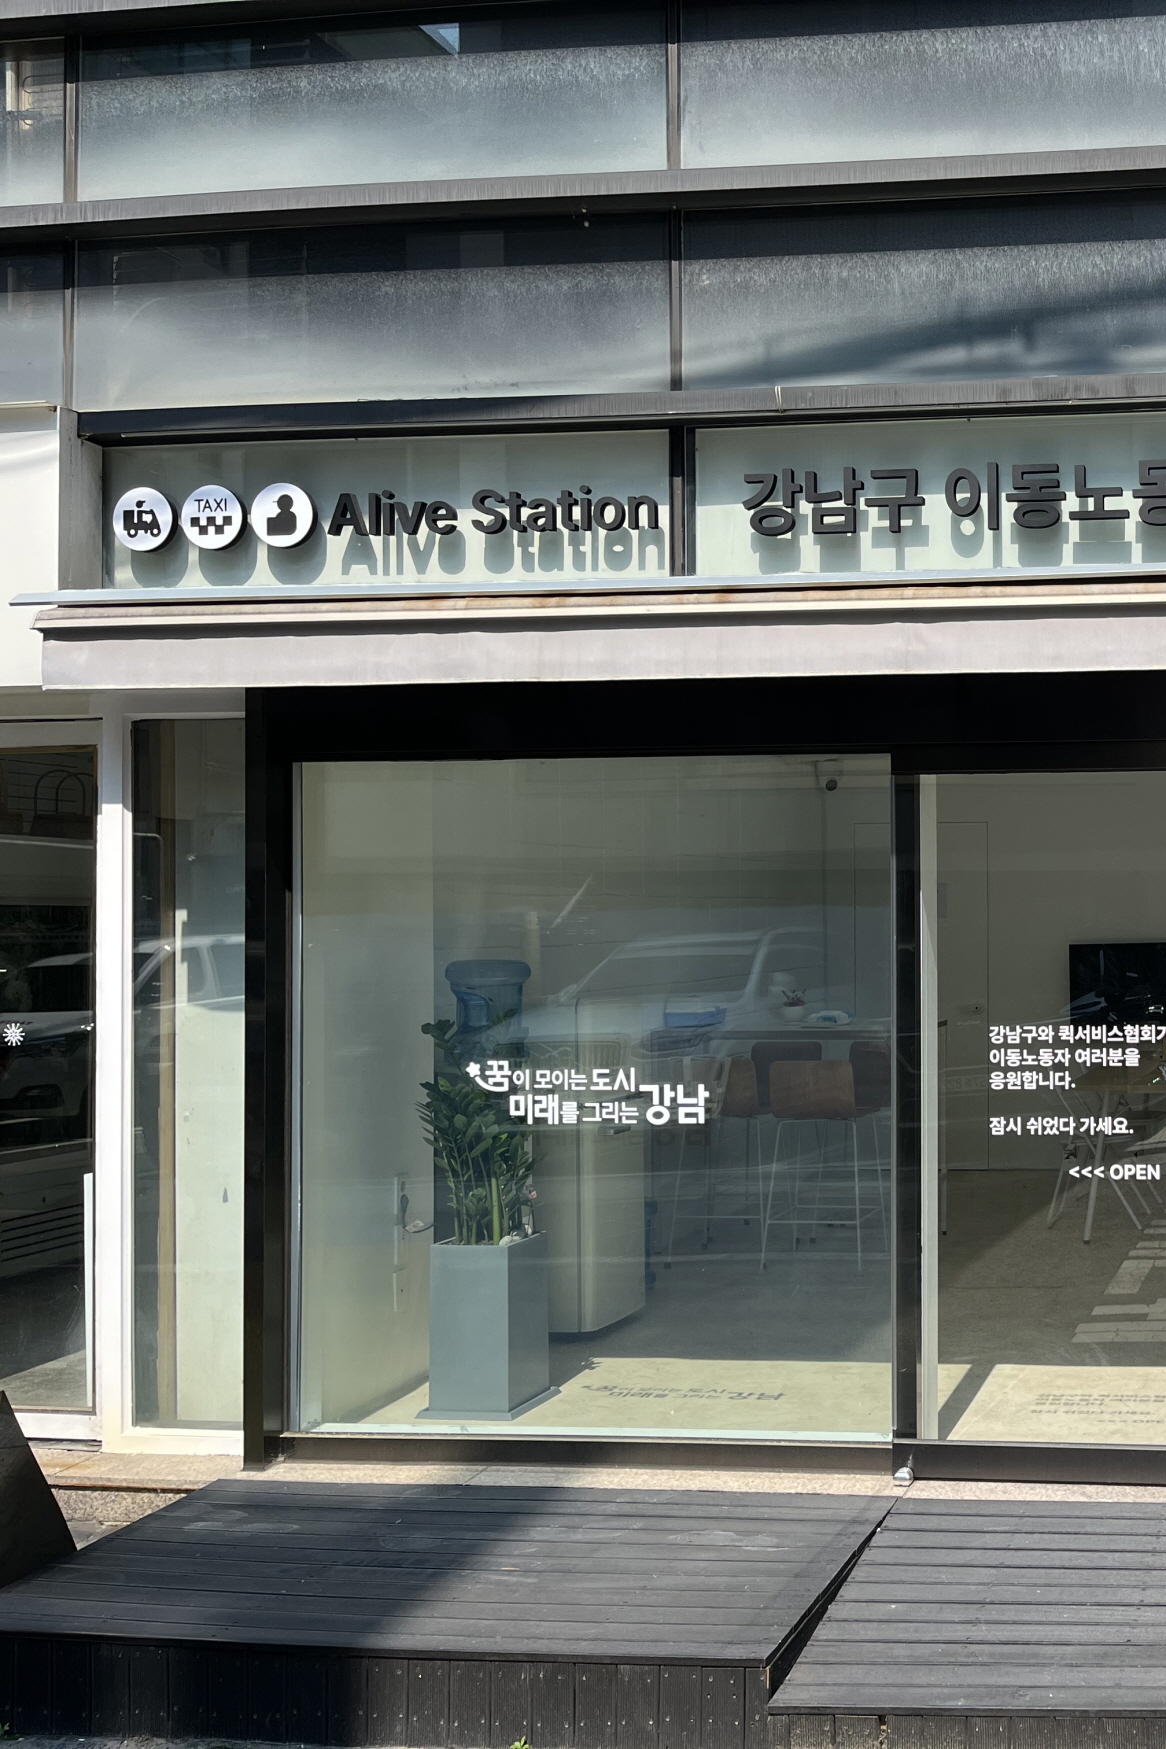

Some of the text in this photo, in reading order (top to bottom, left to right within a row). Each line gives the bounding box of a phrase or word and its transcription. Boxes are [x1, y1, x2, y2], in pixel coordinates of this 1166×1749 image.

[193, 497, 228, 513] TAXI
[327, 484, 660, 537] Alive Station
[742, 467, 925, 537] 강남구
[988, 1024, 1055, 1045] 강남구와
[988, 1047, 1141, 1067] 이동노동자 여러분을
[474, 1060, 636, 1093] 꿈이 모이는 도시
[988, 1070, 1076, 1090] 응원합니다.
[508, 1083, 710, 1126] 미래를 그리는 강남
[988, 1116, 1134, 1136] 잠시 쉬었다 가세요.
[1109, 1163, 1161, 1181] OPEN
